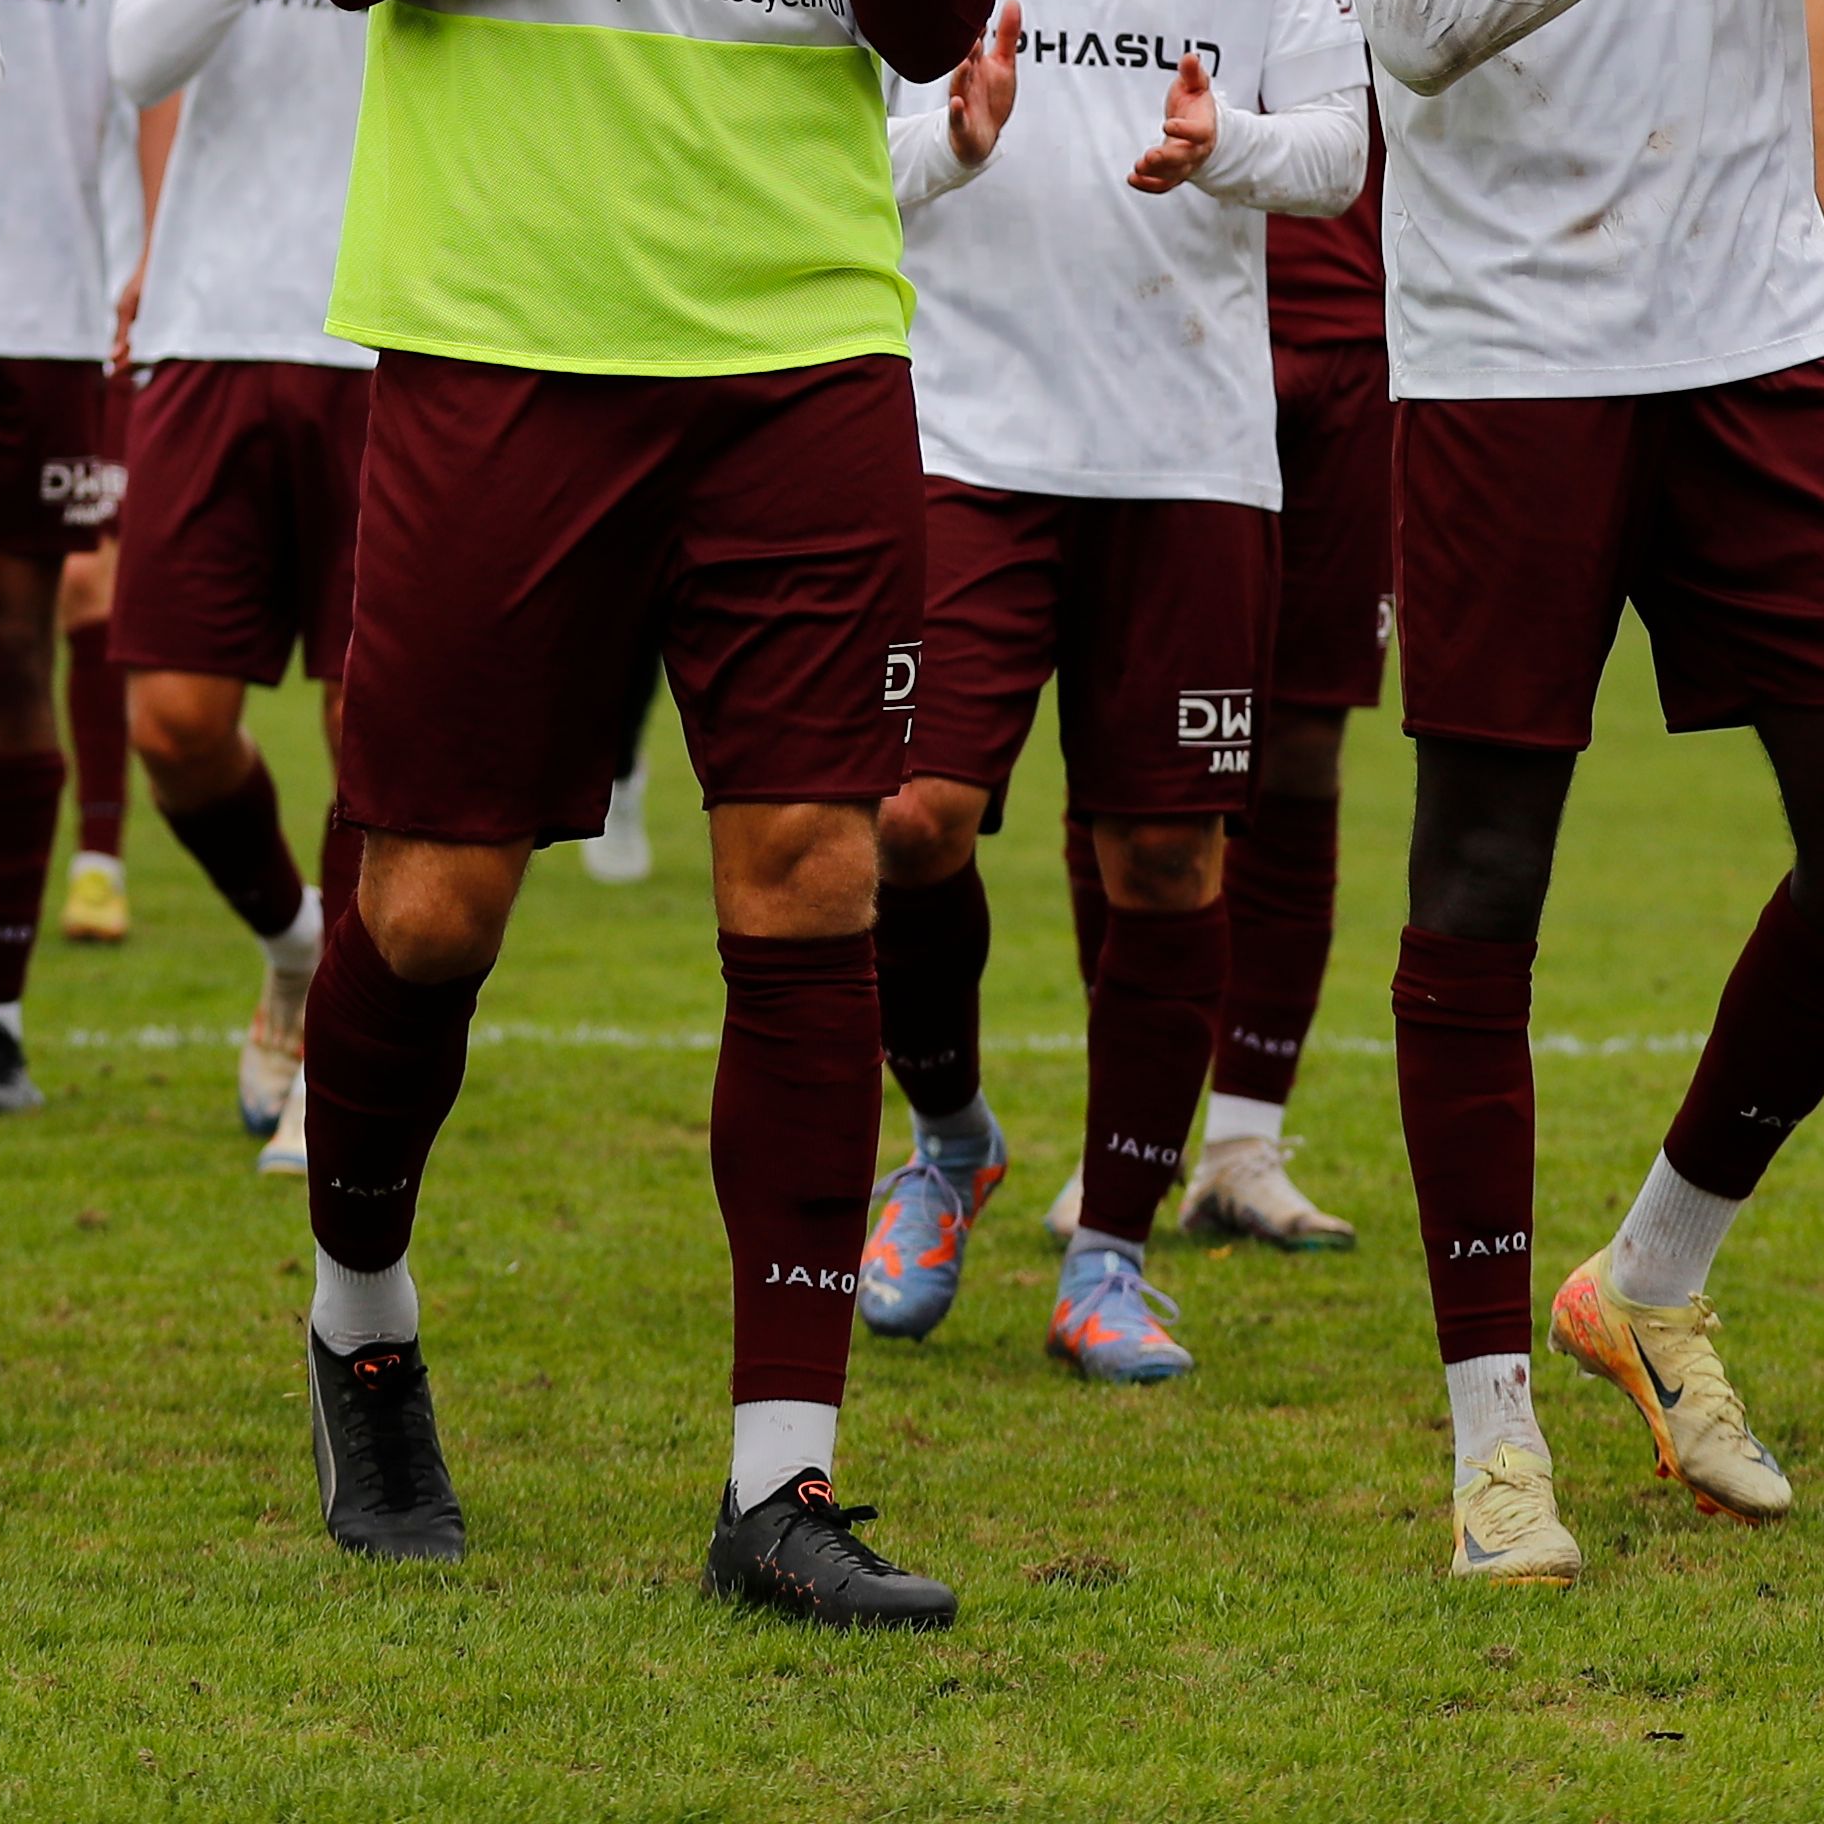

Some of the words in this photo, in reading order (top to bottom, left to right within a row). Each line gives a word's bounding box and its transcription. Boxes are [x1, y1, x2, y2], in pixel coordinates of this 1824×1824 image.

[1106, 1132, 1178, 1164] JAKO
[1450, 1230, 1528, 1260] JAKO
[765, 1262, 856, 1295] JAKO
